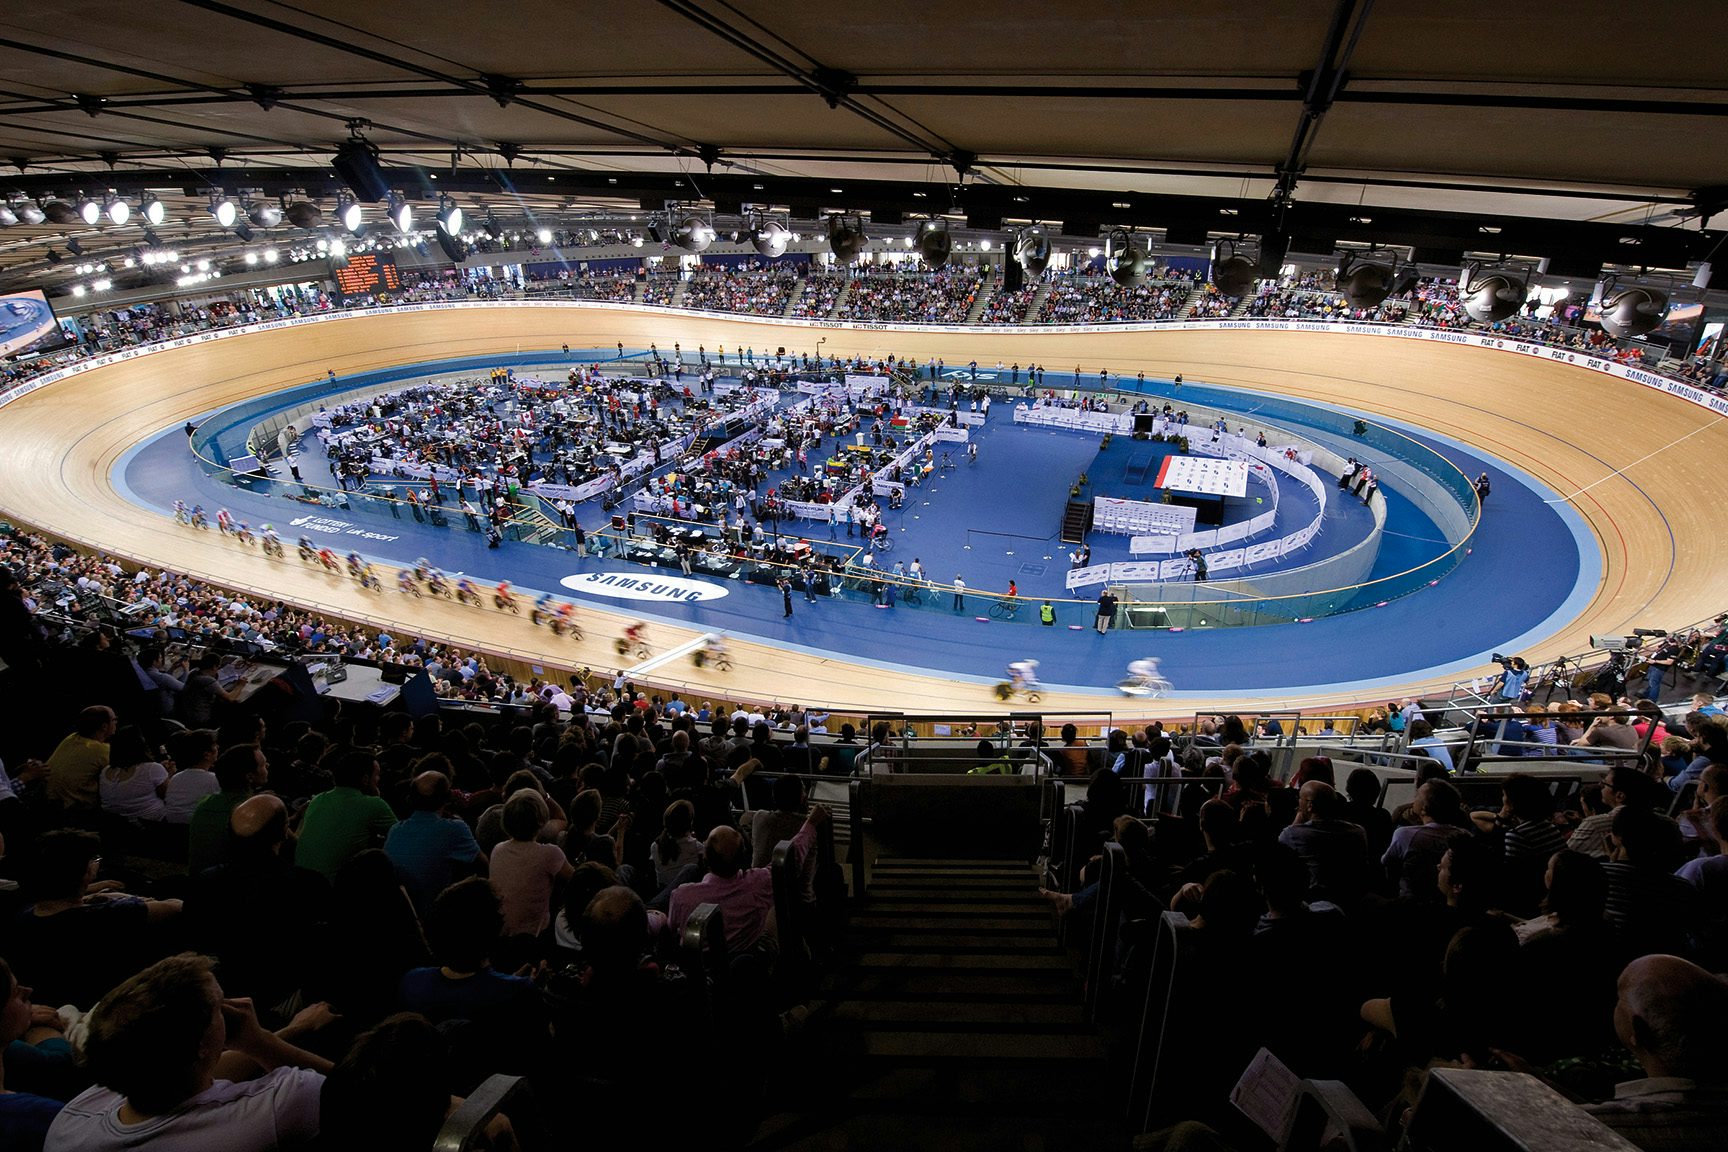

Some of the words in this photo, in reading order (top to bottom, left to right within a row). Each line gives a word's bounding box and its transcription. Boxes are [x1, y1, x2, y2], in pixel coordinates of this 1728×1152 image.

[258, 321, 287, 330] SAMSUNG
[291, 316, 320, 325] SAMSUNG
[325, 312, 353, 320] SAMSUNG
[365, 308, 393, 316] SAMSUNG
[1346, 325, 1382, 334] SAMSUNG
[1387, 328, 1423, 337] SAMSUNG
[1430, 332, 1467, 343] SAMSUNG
[1481, 338, 1495, 347] FIAT
[1516, 344, 1530, 352] FIAT
[1551, 350, 1566, 360] FIAT
[1587, 358, 1602, 369] FIAT
[1626, 369, 1663, 388] SAMSUNG
[1667, 382, 1704, 402] SAMSUNG
[300, 522, 340, 533] FUNDED
[312, 517, 353, 528] LOTTERY
[586, 572, 703, 601] SAMSUNG
